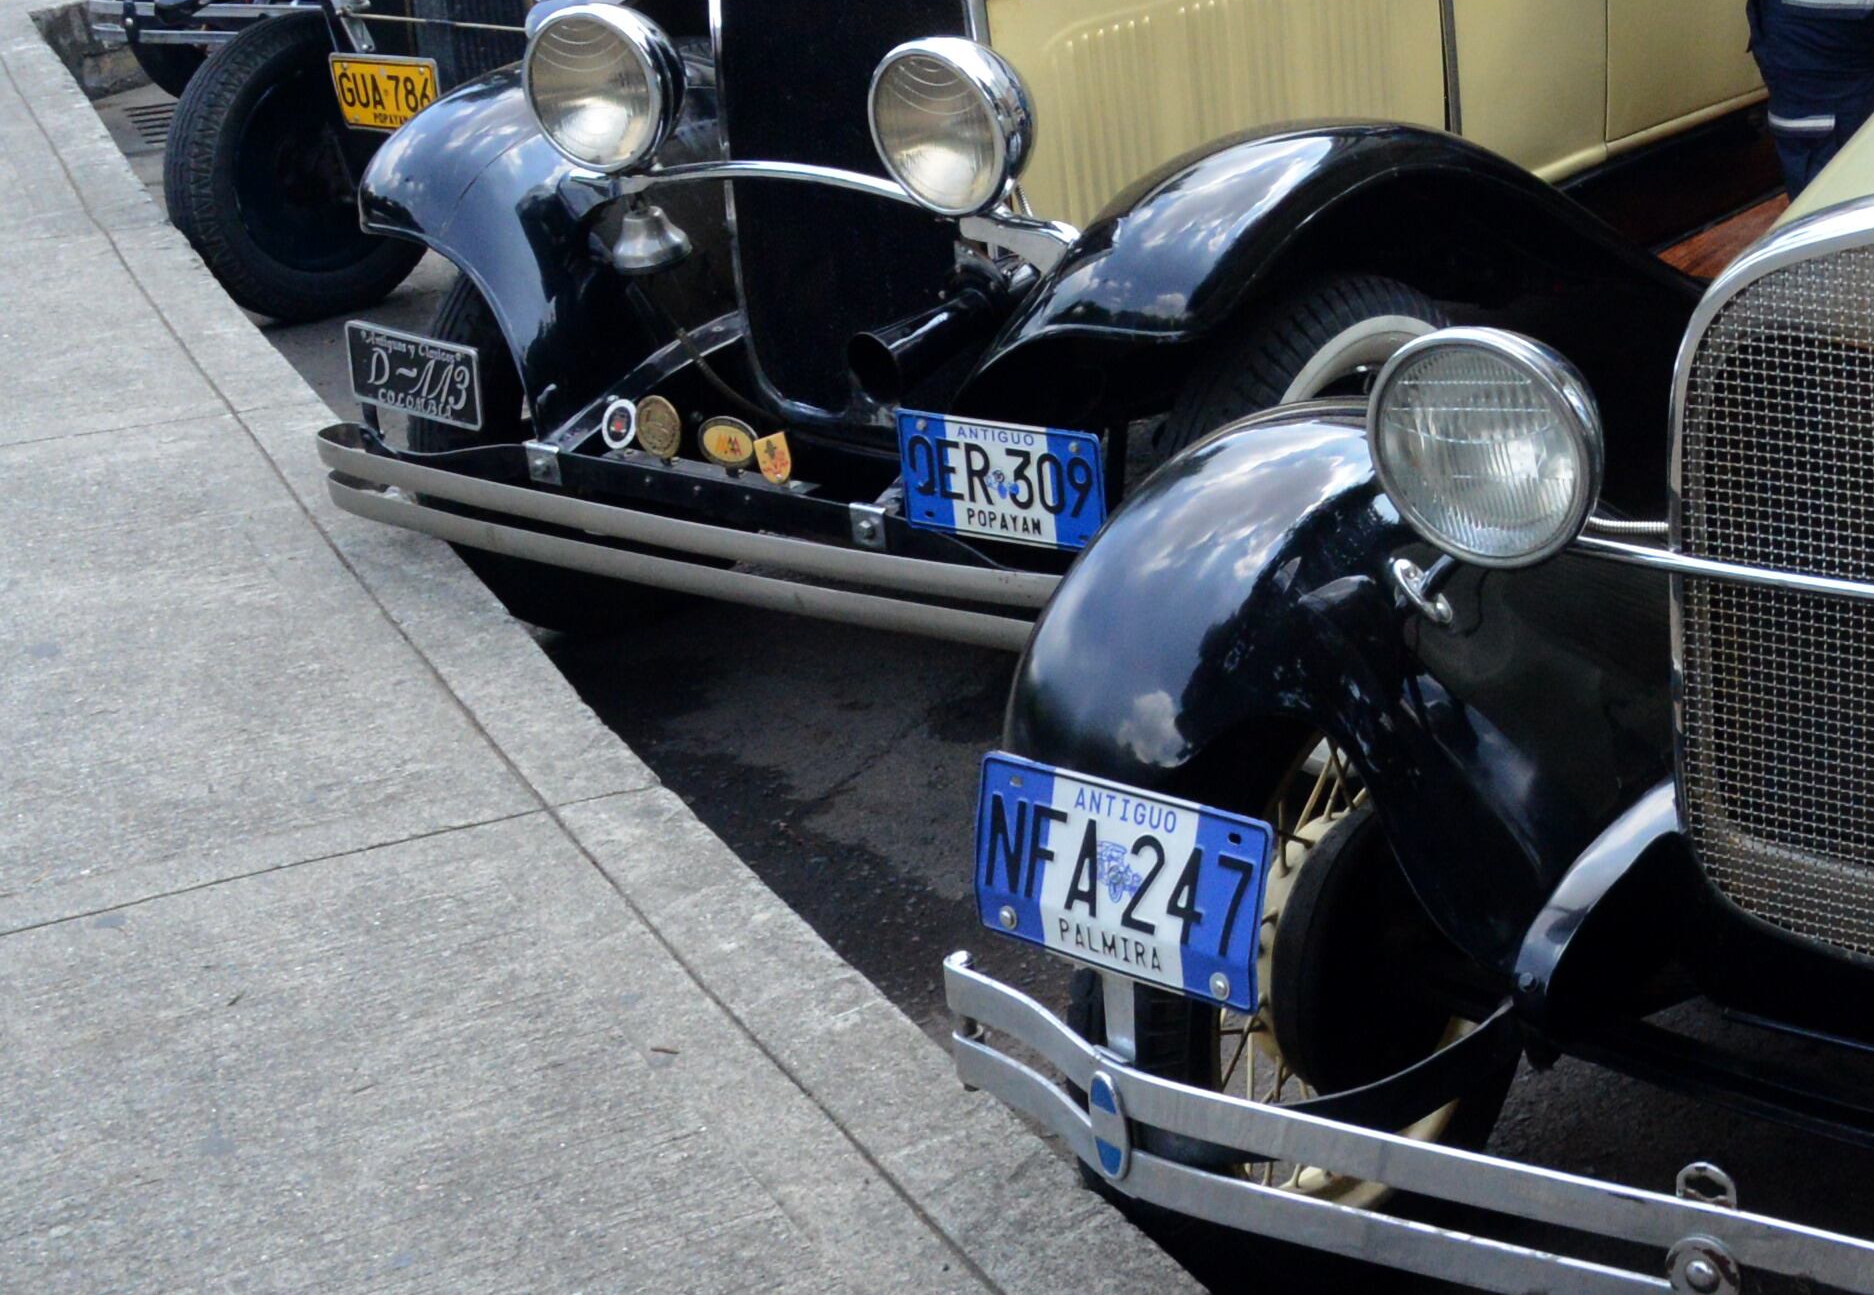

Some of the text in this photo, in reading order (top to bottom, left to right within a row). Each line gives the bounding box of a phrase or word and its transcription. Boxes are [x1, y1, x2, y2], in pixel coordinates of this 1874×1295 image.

[339, 72, 431, 113] GUA 786
[957, 426, 1035, 447] ANTIGUO
[1004, 447, 1093, 518] 309
[966, 507, 1042, 535] POPAYAN
[1074, 787, 1177, 834] ANTIGUO
[985, 793, 1254, 958] NFA 247
[1058, 918, 1162, 972] PALMIRA
